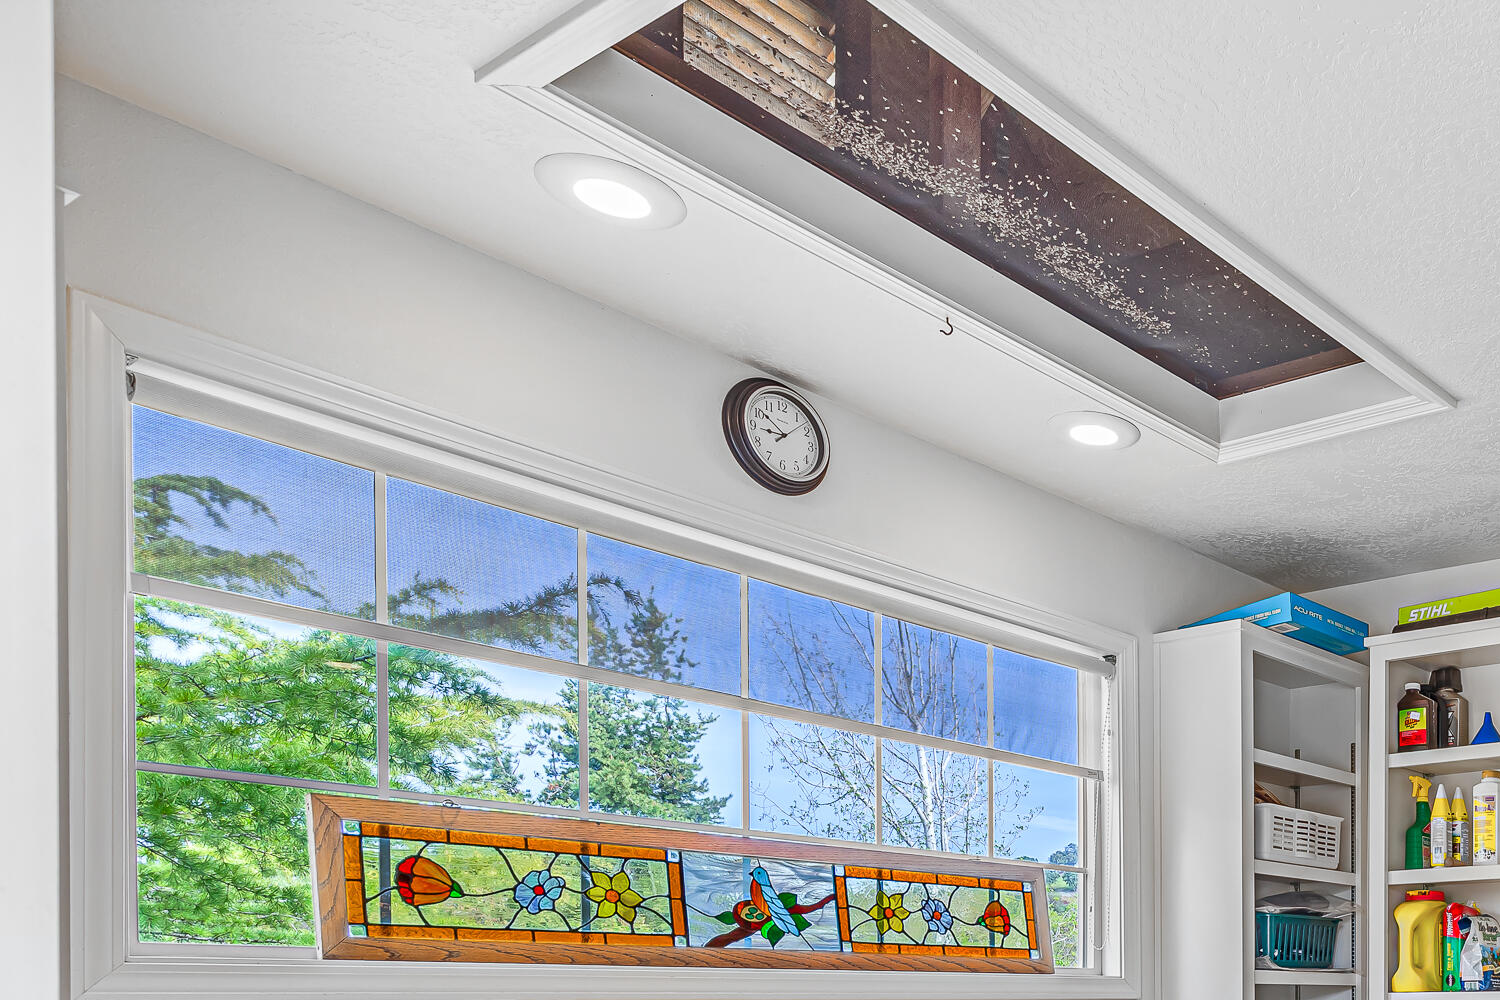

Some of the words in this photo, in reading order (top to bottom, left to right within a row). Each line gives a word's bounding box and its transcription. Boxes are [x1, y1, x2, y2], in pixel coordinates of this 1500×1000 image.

[765, 400, 773, 412] 11
[777, 400, 788, 413] 12
[754, 407, 765, 419] 10
[749, 419, 757, 430] 9
[803, 426, 810, 437] 2
[754, 435, 761, 447] 8
[807, 441, 814, 452] 3
[766, 450, 772, 460] 7
[803, 455, 808, 464] 4
[779, 460, 786, 470] 6
[793, 460, 800, 471] 5
[1407, 603, 1451, 623] STIHL
